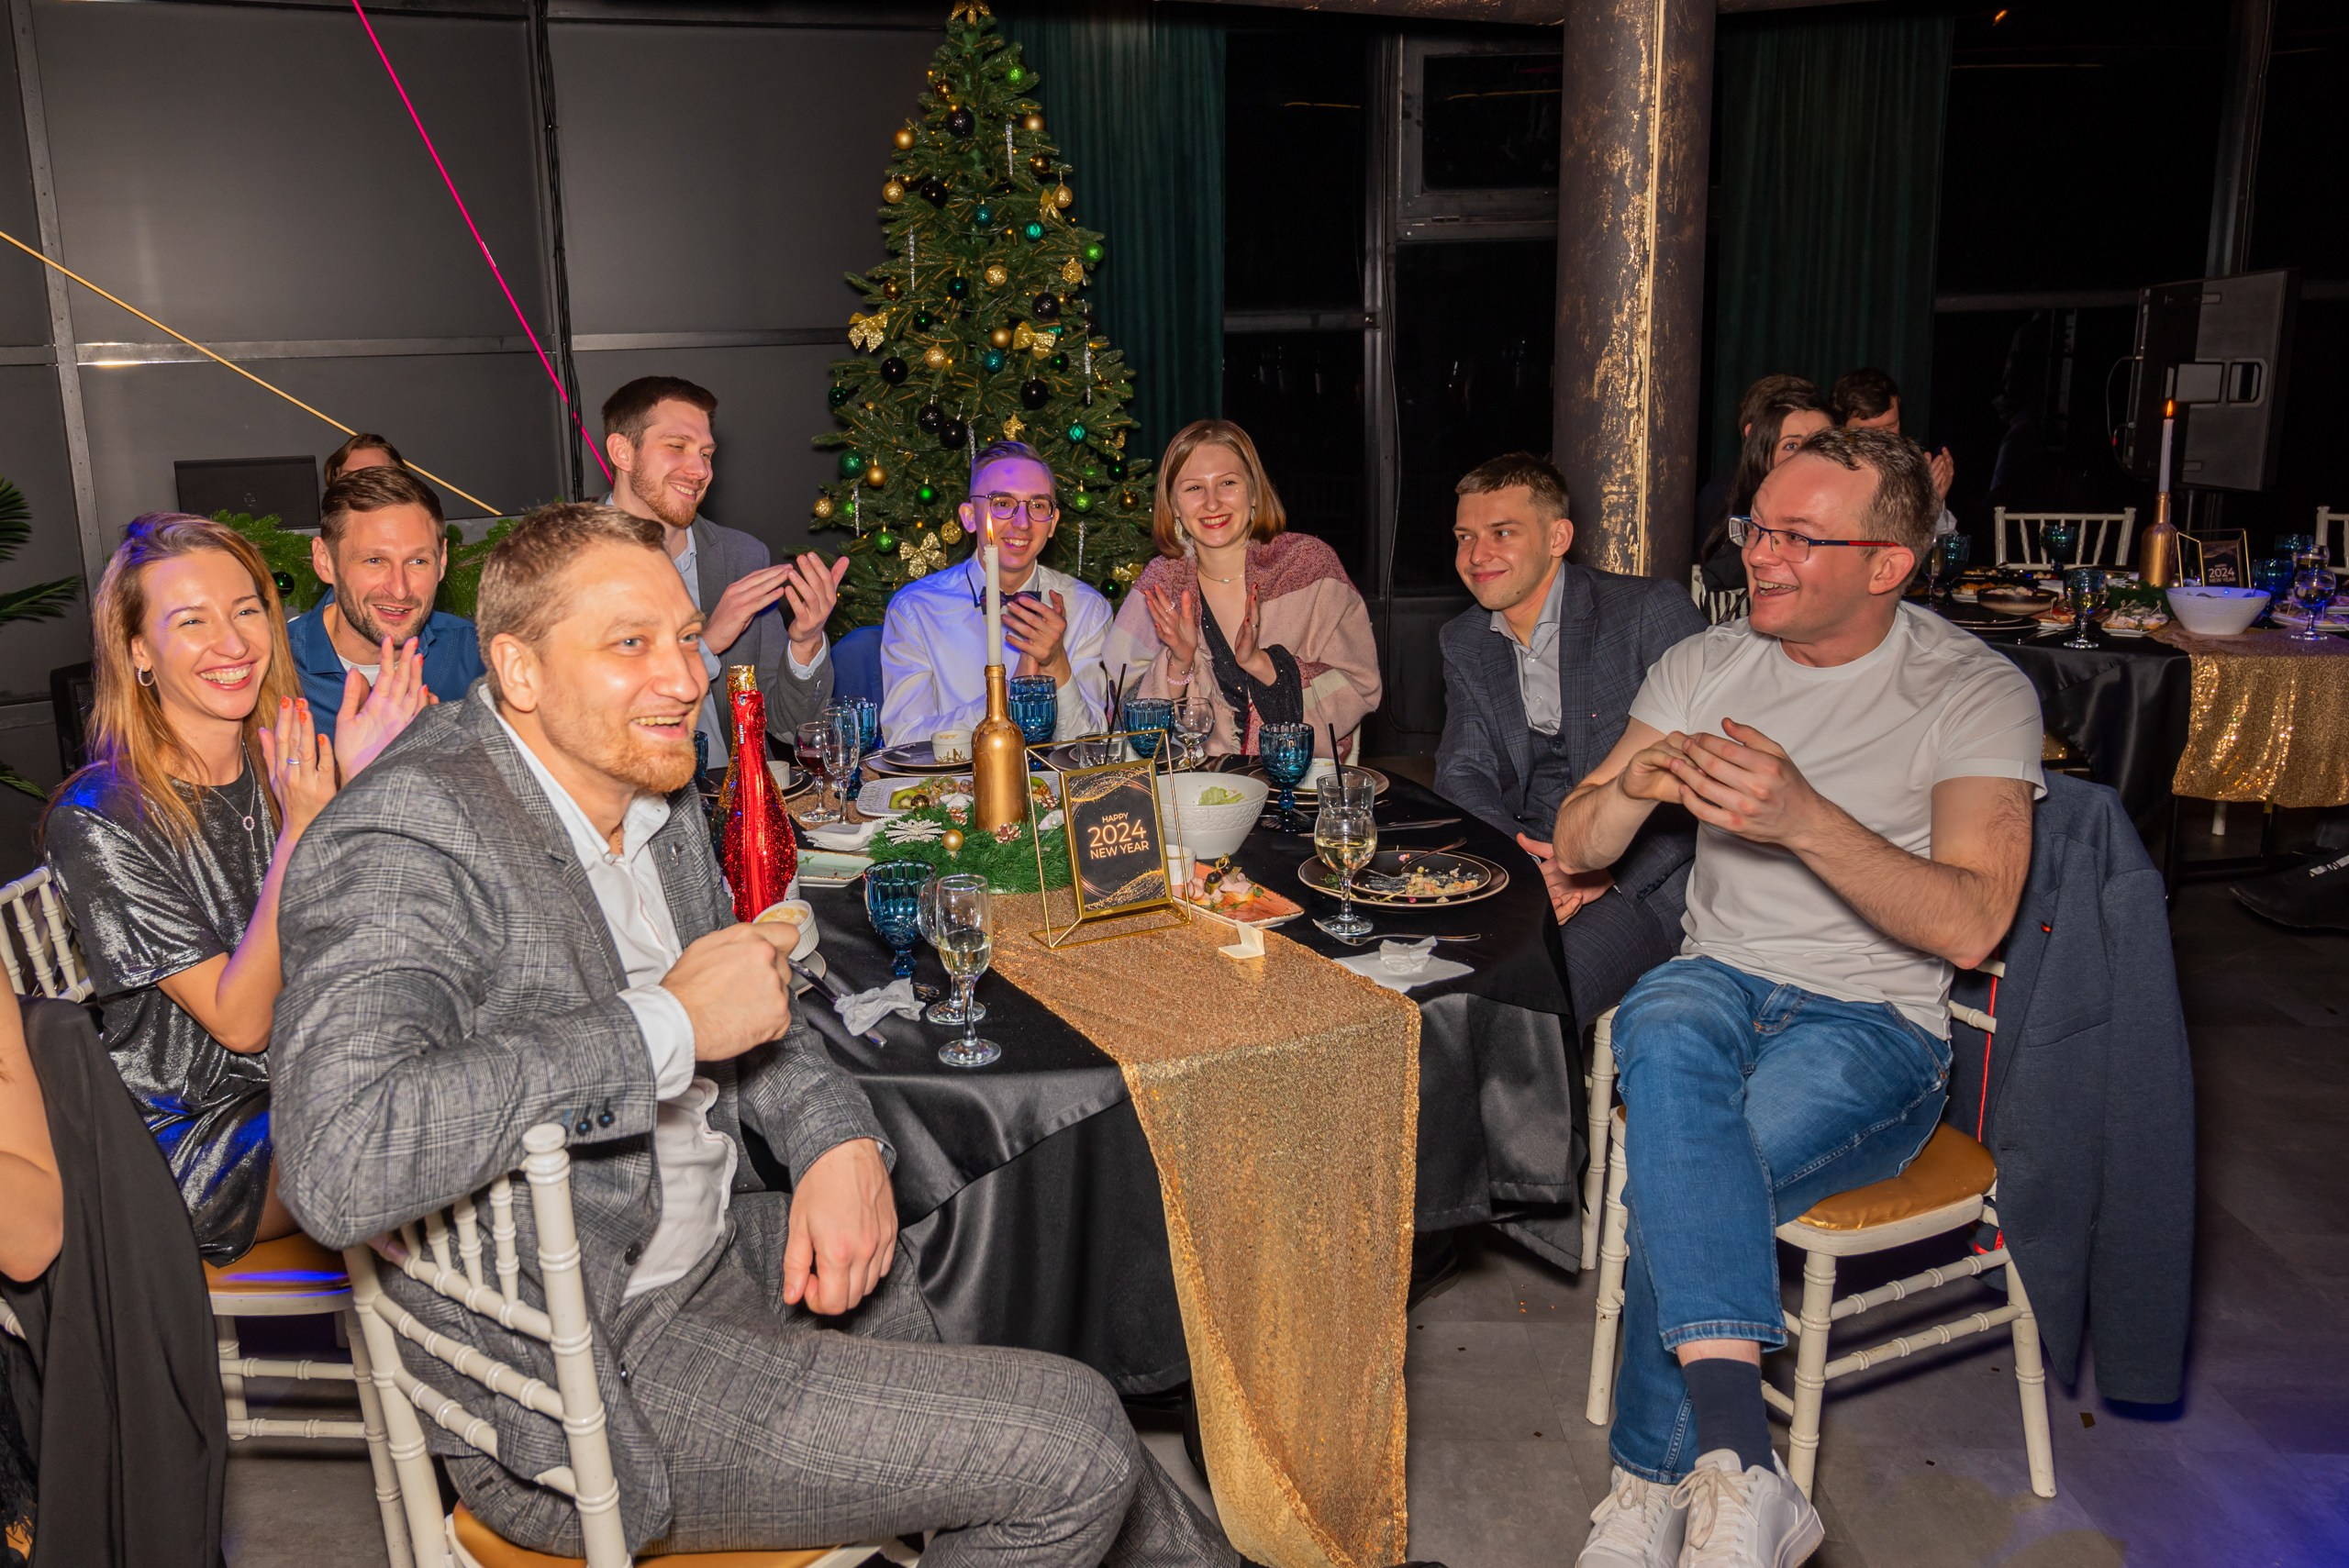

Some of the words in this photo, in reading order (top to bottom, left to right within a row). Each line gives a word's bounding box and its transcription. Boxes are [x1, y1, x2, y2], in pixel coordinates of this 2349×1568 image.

[2208, 567, 2235, 578] 2024
[1101, 812, 1129, 824] HAPPY
[1087, 818, 1147, 848] 2024
[1090, 845, 1118, 860] NEW
[1119, 840, 1150, 854] YEAR
